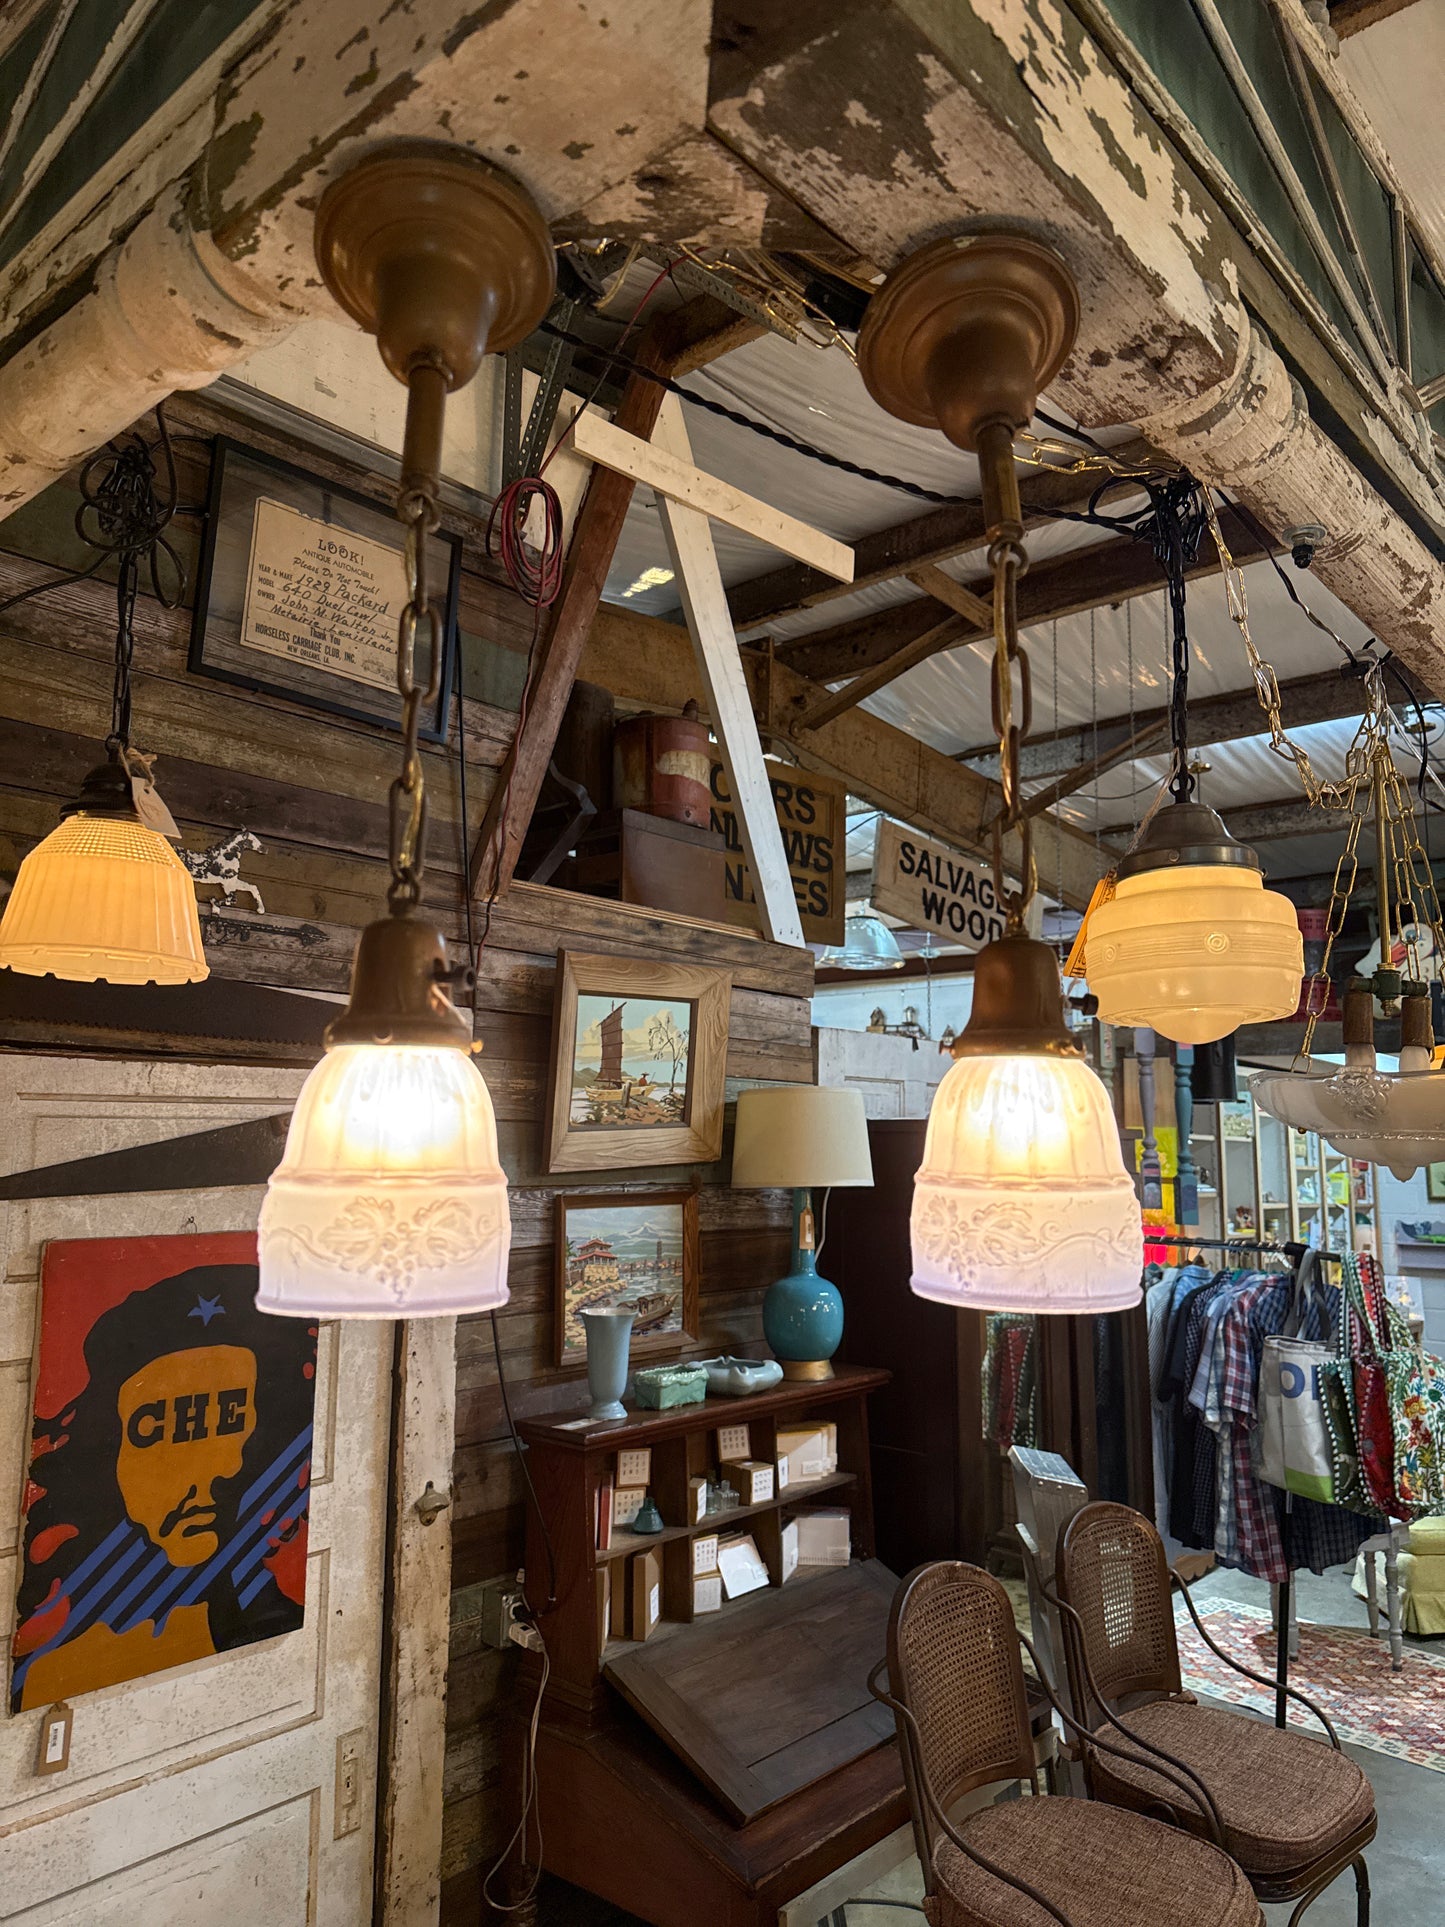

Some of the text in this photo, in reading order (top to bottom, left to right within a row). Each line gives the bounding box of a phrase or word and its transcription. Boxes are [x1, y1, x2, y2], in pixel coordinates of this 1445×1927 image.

[302, 548, 375, 581] ANTIQUE AUTOMOBILE
[318, 538, 364, 566] LOOK!
[258, 563, 271, 574] YEAR
[272, 568, 278, 576] &
[279, 570, 293, 581] MAKE
[295, 573, 331, 594] 1929
[258, 575, 275, 588] MODEL
[282, 582, 312, 600] 640
[292, 556, 380, 596] Please Do Not Touch!
[257, 588, 276, 601] OWNER
[281, 594, 309, 612] John
[330, 612, 376, 635] Walton
[255, 622, 357, 665] HORSELESS CARRIAGE CLUB, INC.
[287, 645, 298, 654] NEW
[310, 626, 341, 646] Thank You
[922, 887, 1004, 943] WOOD
[127, 1387, 248, 1449] CHE
